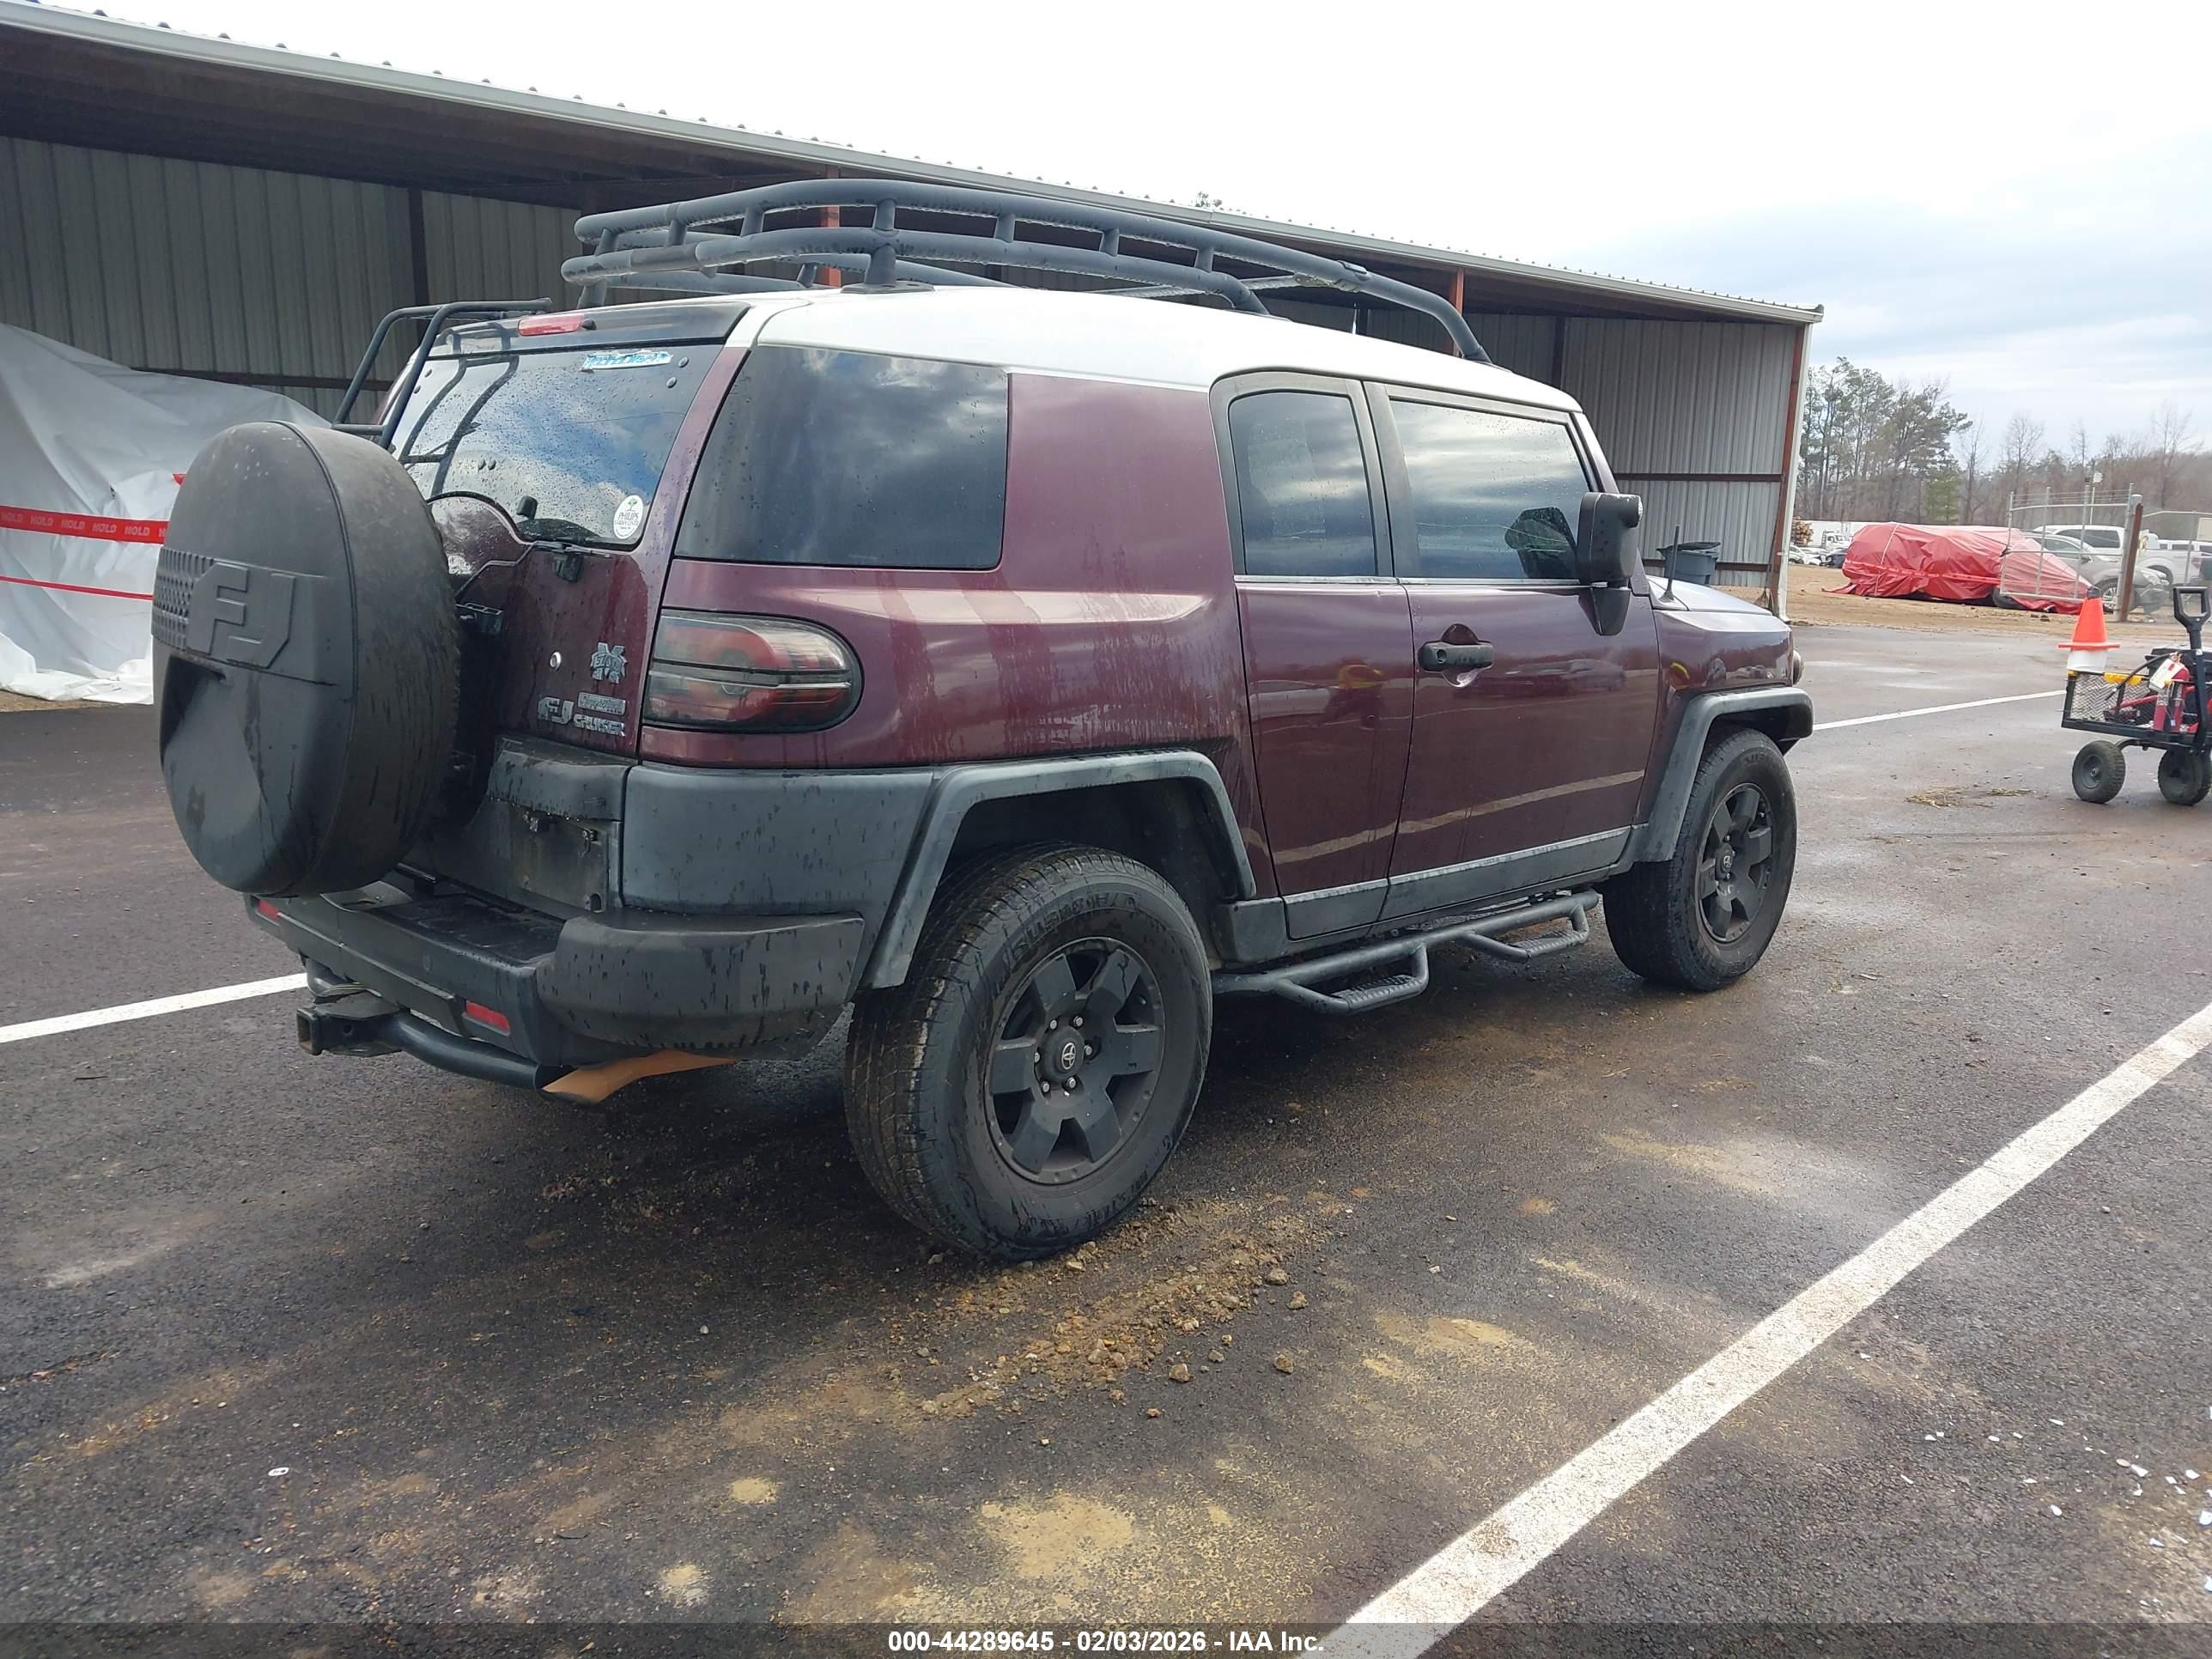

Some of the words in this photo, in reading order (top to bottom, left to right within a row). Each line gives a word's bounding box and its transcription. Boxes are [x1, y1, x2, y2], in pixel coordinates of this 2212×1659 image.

[30, 514, 54, 526] HOLD
[61, 518, 85, 531] HOLD
[92, 522, 117, 534] HOLD
[125, 525, 150, 537] HOLD
[186, 562, 297, 669] FJ
[538, 696, 574, 725] FJ
[573, 714, 626, 737] CRUISER
